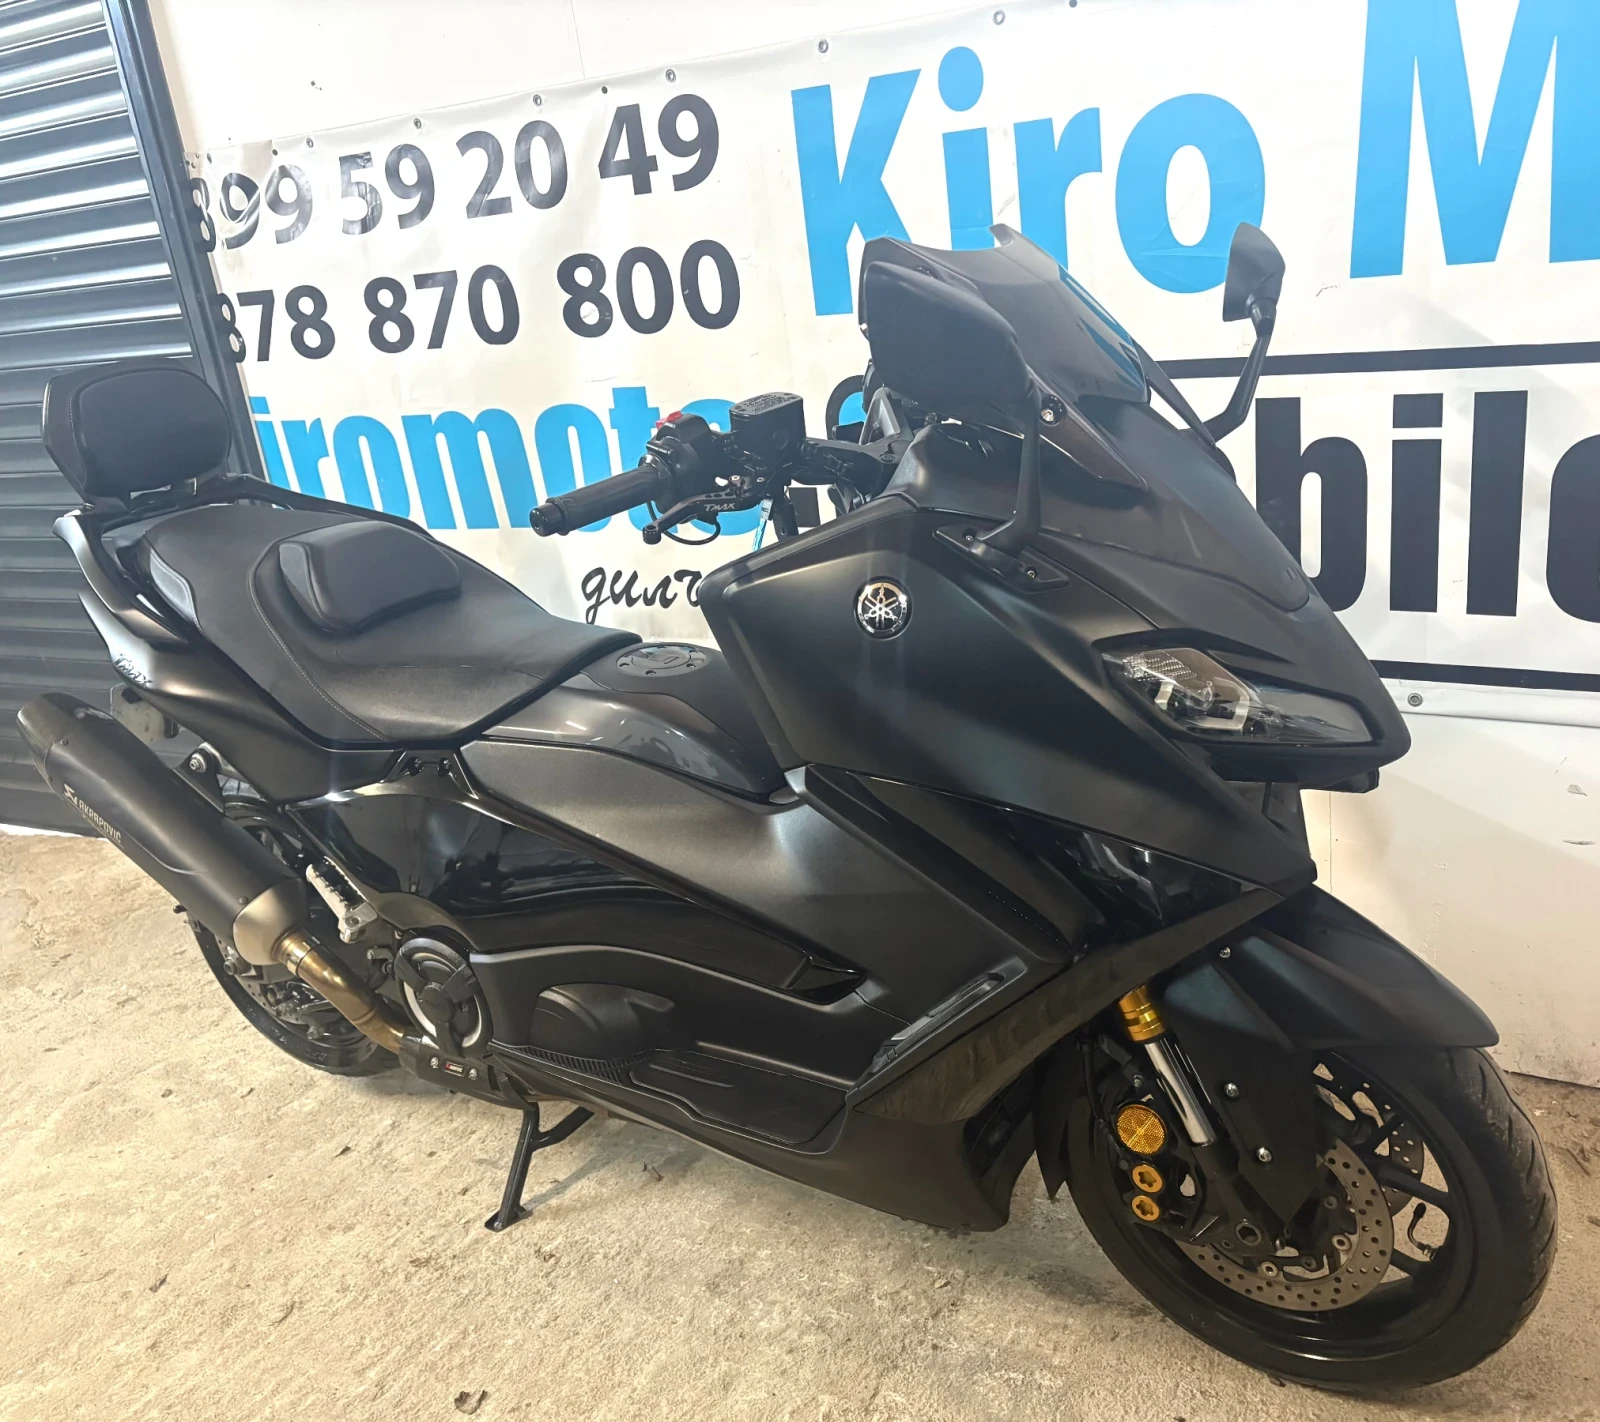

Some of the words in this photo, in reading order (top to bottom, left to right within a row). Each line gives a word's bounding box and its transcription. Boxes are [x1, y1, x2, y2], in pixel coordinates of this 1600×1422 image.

[339, 143, 435, 236] 59
[456, 120, 569, 220] 20
[598, 94, 720, 195] 49
[791, 46, 1266, 317] Kiro
[363, 264, 520, 353] 870
[557, 239, 741, 338] 800
